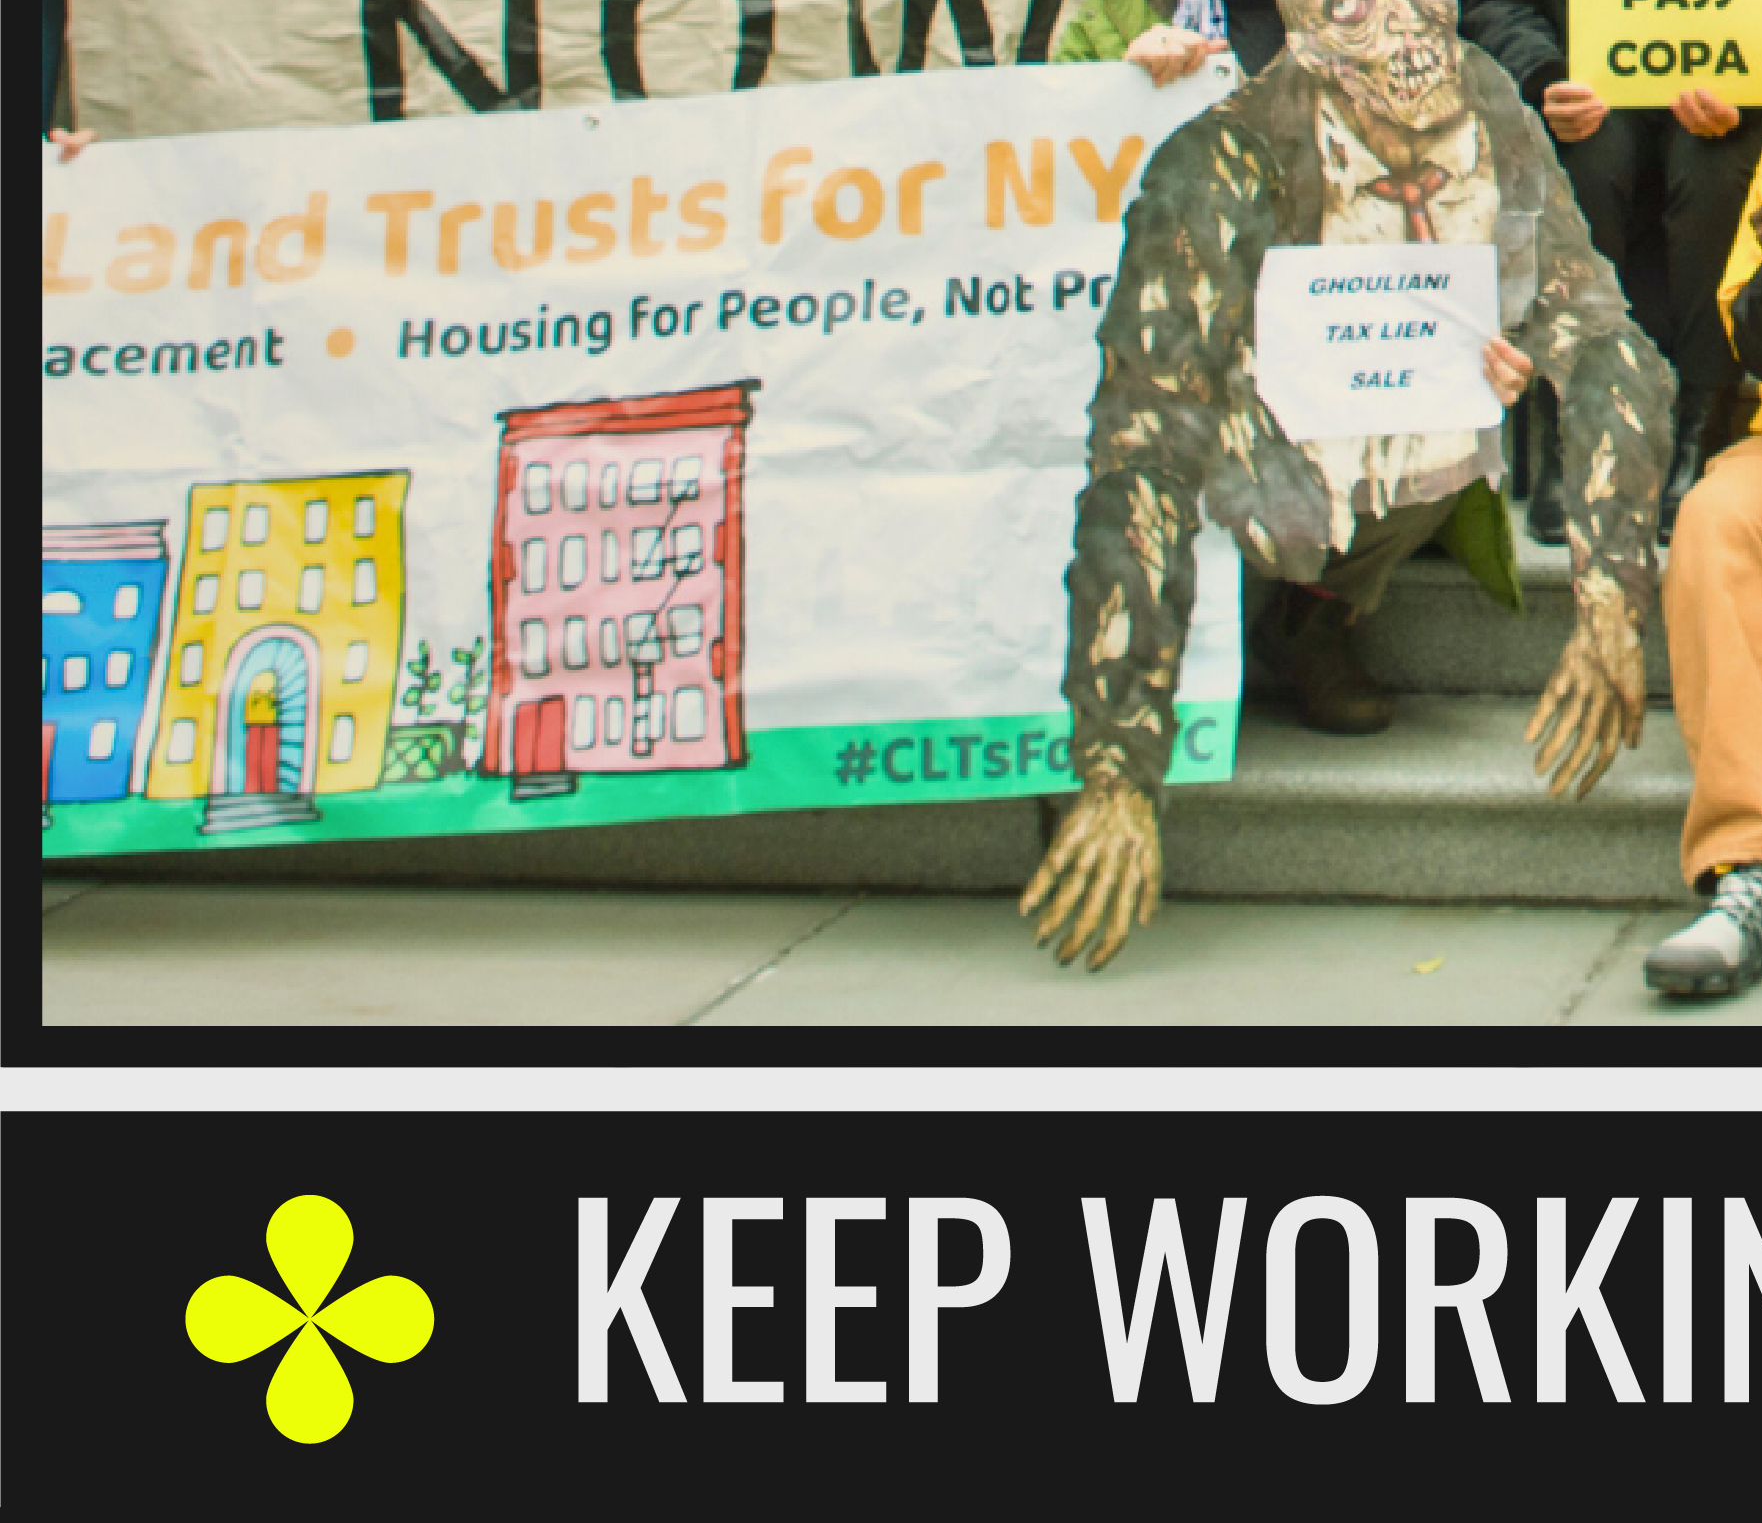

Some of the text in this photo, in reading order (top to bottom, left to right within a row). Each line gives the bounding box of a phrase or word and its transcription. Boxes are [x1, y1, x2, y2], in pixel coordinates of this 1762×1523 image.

[1607, 39, 1749, 76] COPA
[42, 134, 1147, 295] Land Trusts for NY
[1308, 274, 1451, 296] GHOULIANI
[398, 304, 613, 355] Housing
[630, 296, 702, 339] for
[717, 278, 925, 334] People,
[945, 274, 1034, 317] Not
[1325, 321, 1439, 343] TAX LIEN
[43, 326, 285, 377] acement
[1350, 369, 1415, 390] SALE
